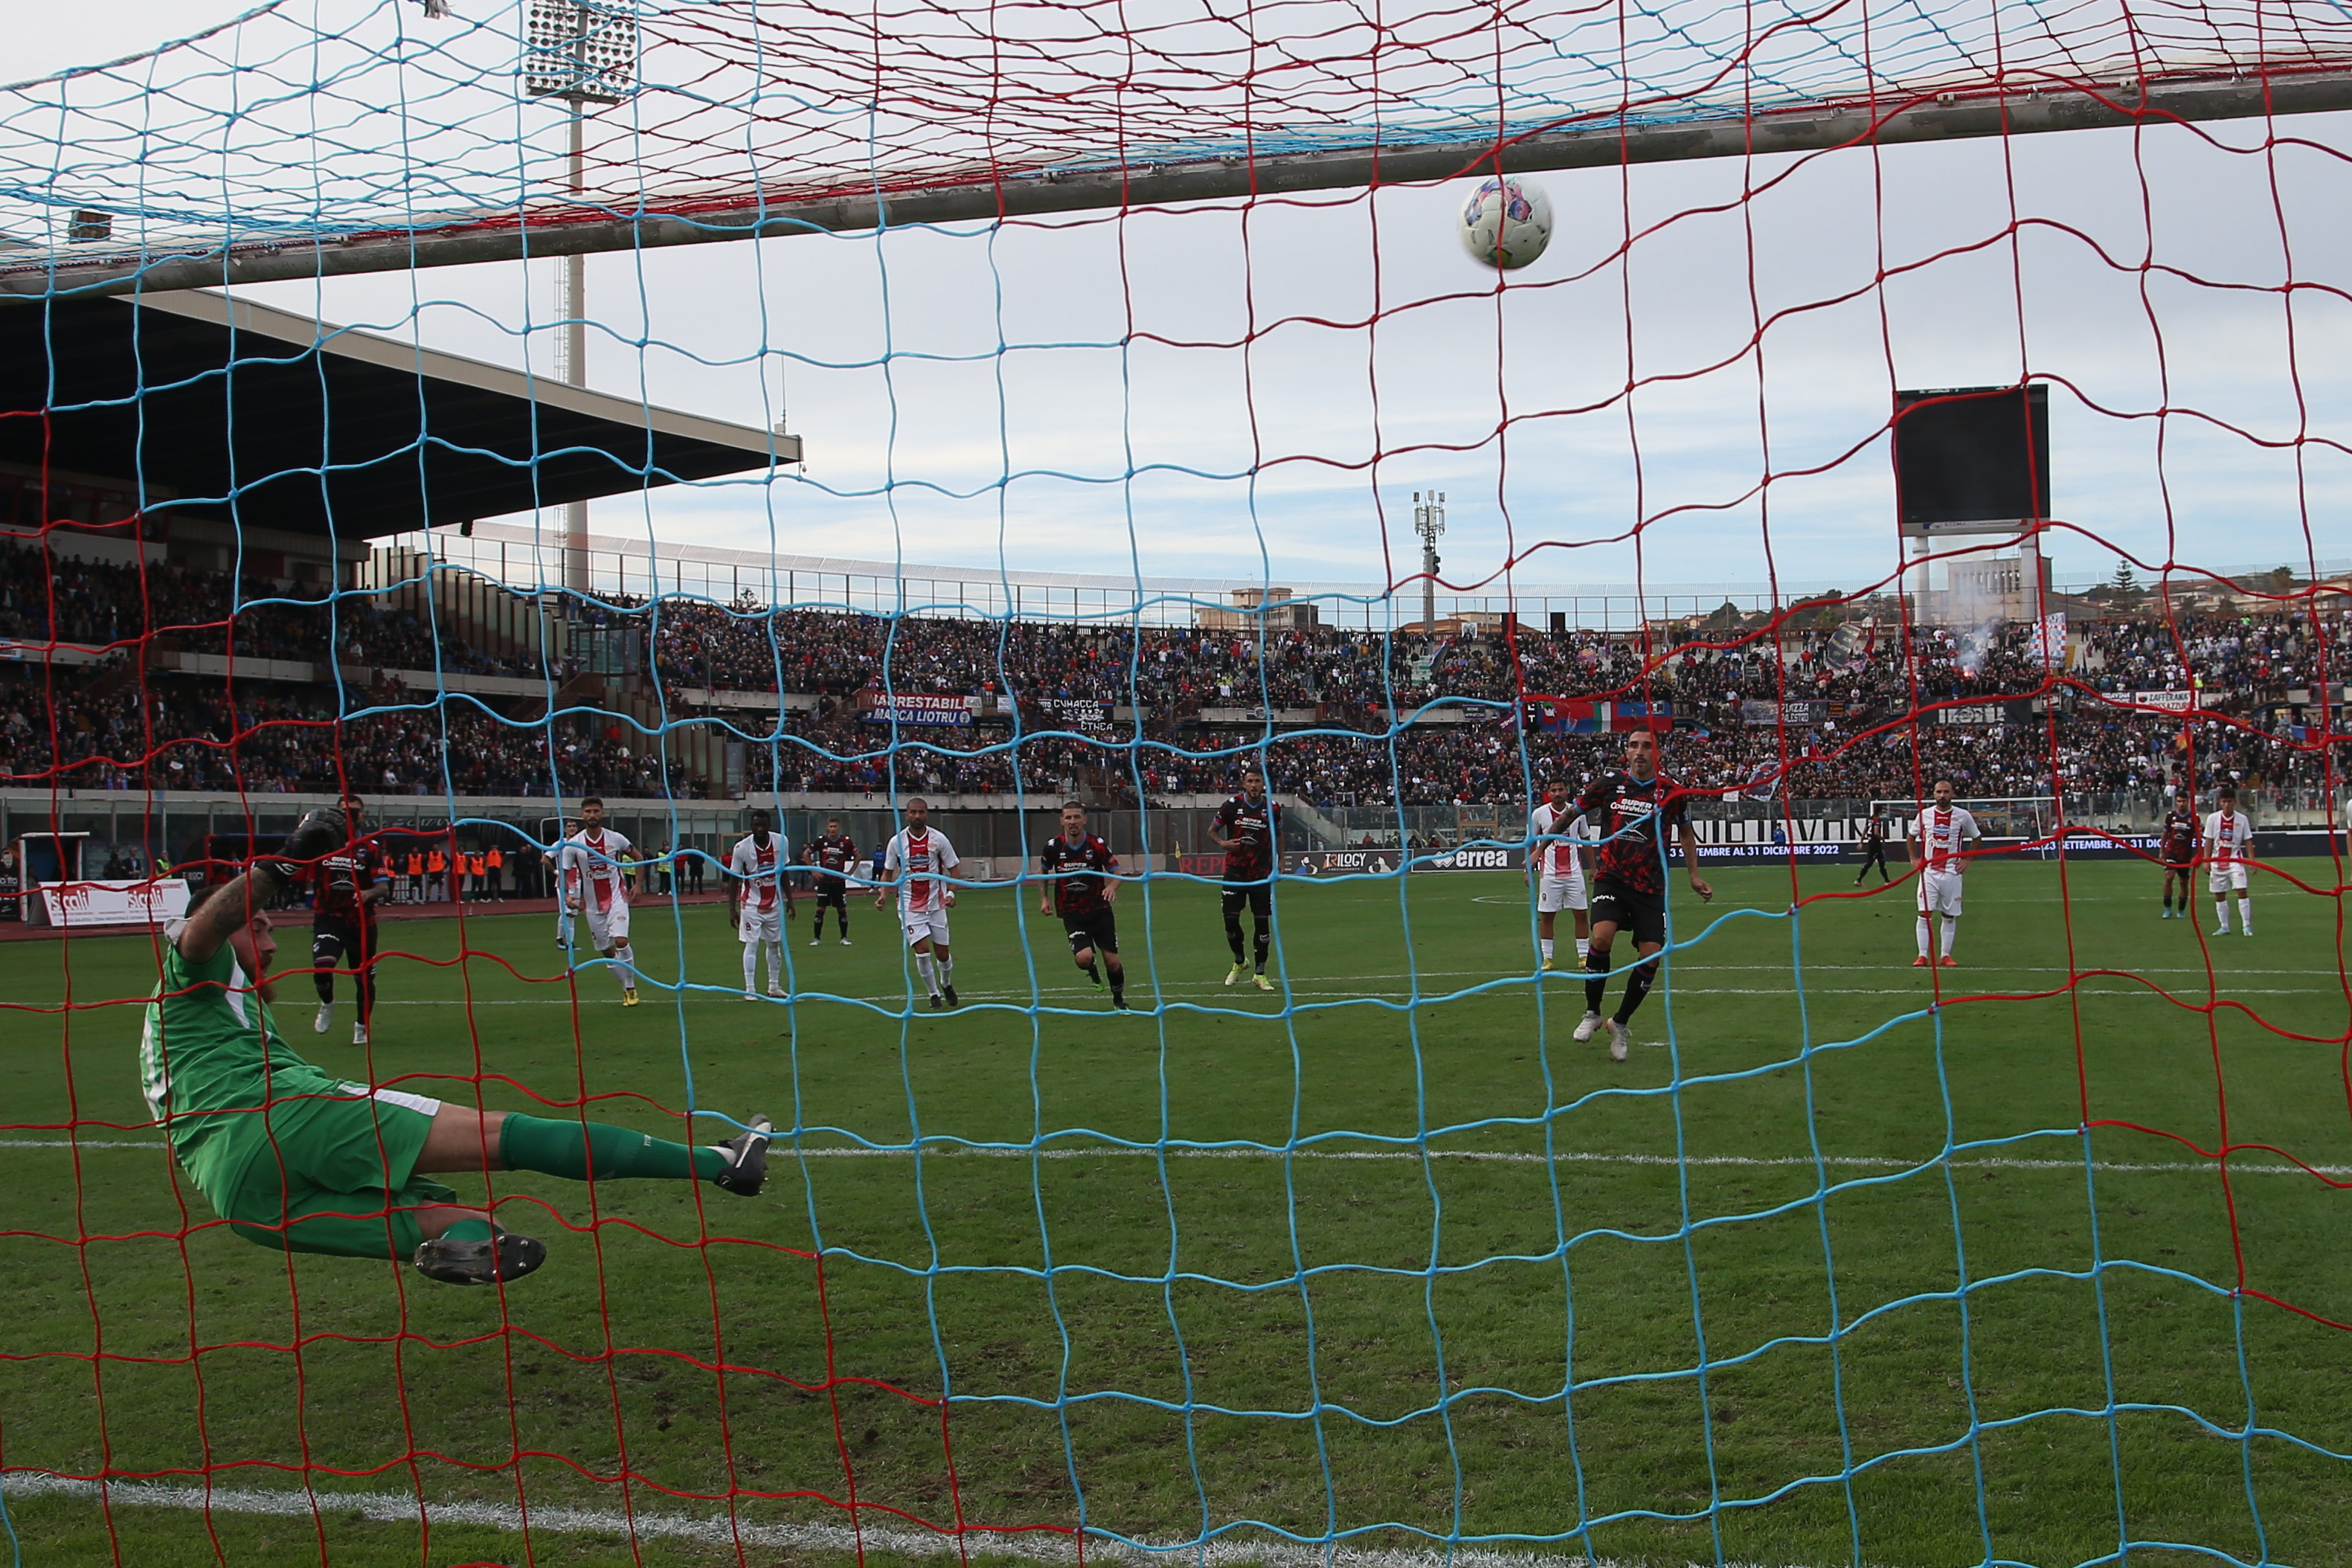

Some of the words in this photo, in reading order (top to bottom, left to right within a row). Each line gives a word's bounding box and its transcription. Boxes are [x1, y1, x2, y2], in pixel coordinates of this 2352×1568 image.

[916, 710, 957, 723] LIOTRU
[1621, 798, 1653, 811] SUPER
[2130, 839, 2142, 848] 31
[1733, 847, 1746, 857] AL
[1747, 846, 1759, 856] 31
[1813, 845, 1839, 855] 2022
[1325, 852, 1366, 867] TRILOGY
[51, 888, 89, 911] sicali
[128, 887, 163, 908] sicali
[1542, 893, 1546, 901] 9
